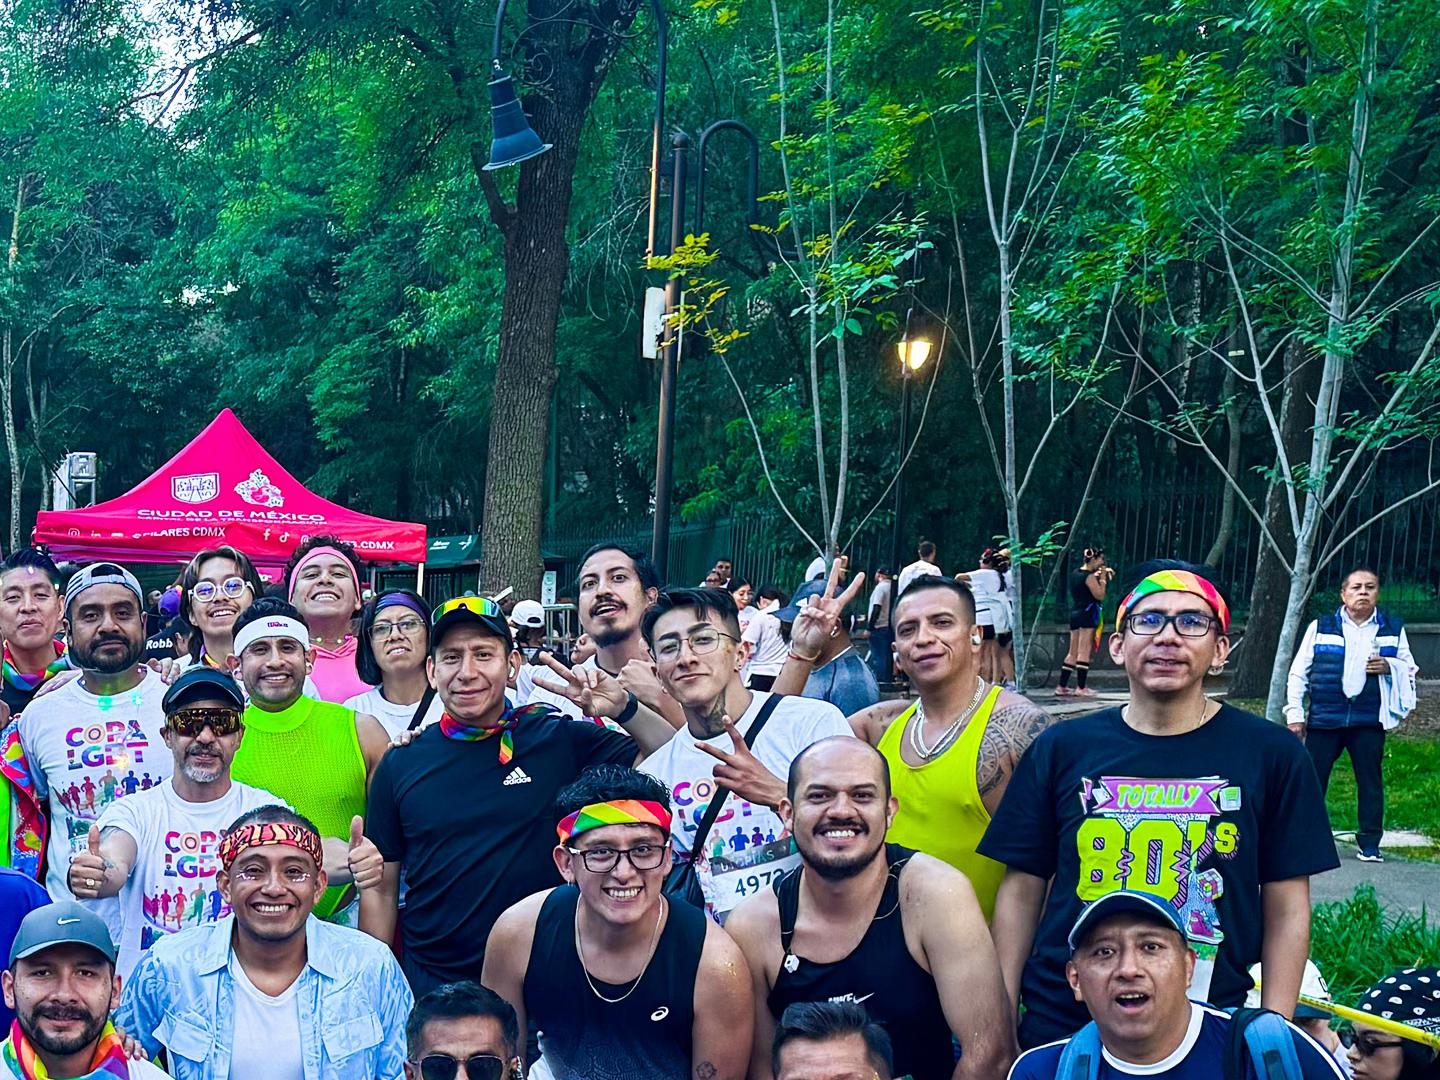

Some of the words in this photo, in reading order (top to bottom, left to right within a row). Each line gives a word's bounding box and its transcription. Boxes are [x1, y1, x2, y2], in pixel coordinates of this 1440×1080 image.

[137, 509, 213, 517] CIUDAD
[218, 510, 245, 518] DE
[249, 510, 325, 521] MÉXICO
[192, 526, 226, 537] CDMX
[65, 719, 148, 747] COPA
[66, 741, 149, 771] LGBT
[503, 776, 532, 786] adidas
[1116, 783, 1203, 808] TOTALLY
[164, 830, 227, 853] COP
[164, 853, 223, 878] LGB
